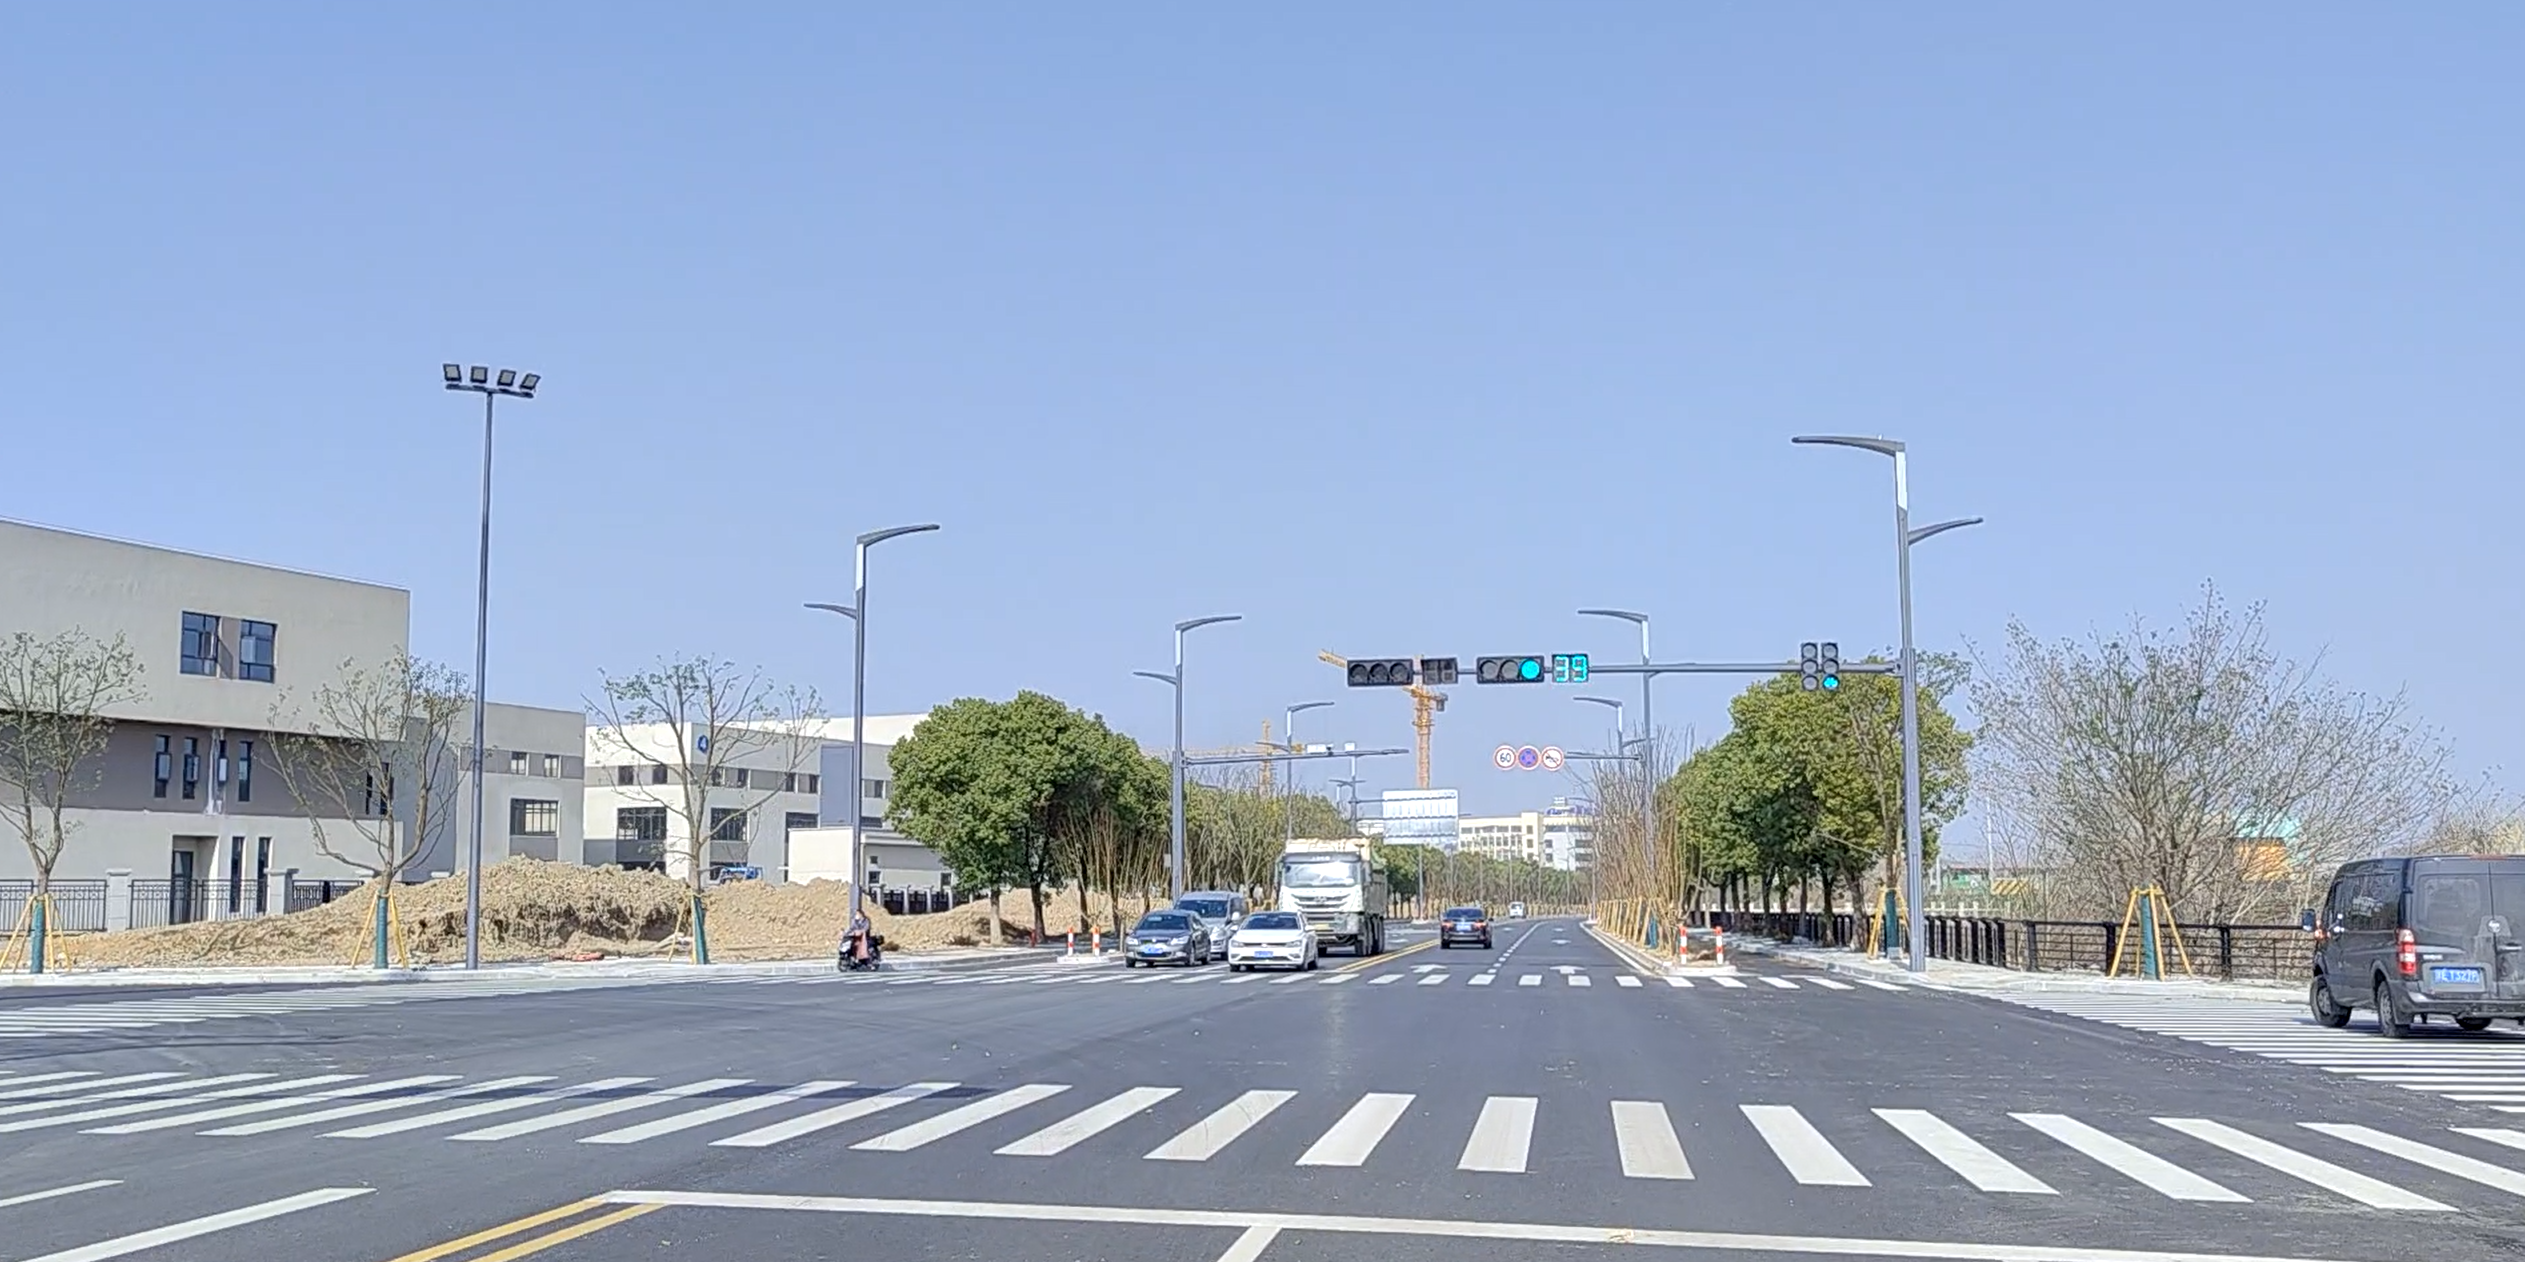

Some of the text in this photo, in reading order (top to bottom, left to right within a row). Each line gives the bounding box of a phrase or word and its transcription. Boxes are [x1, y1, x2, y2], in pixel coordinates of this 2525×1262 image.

[1555, 656, 1587, 681] 39
[700, 737, 706, 749] 4
[1500, 752, 1511, 763] 60
